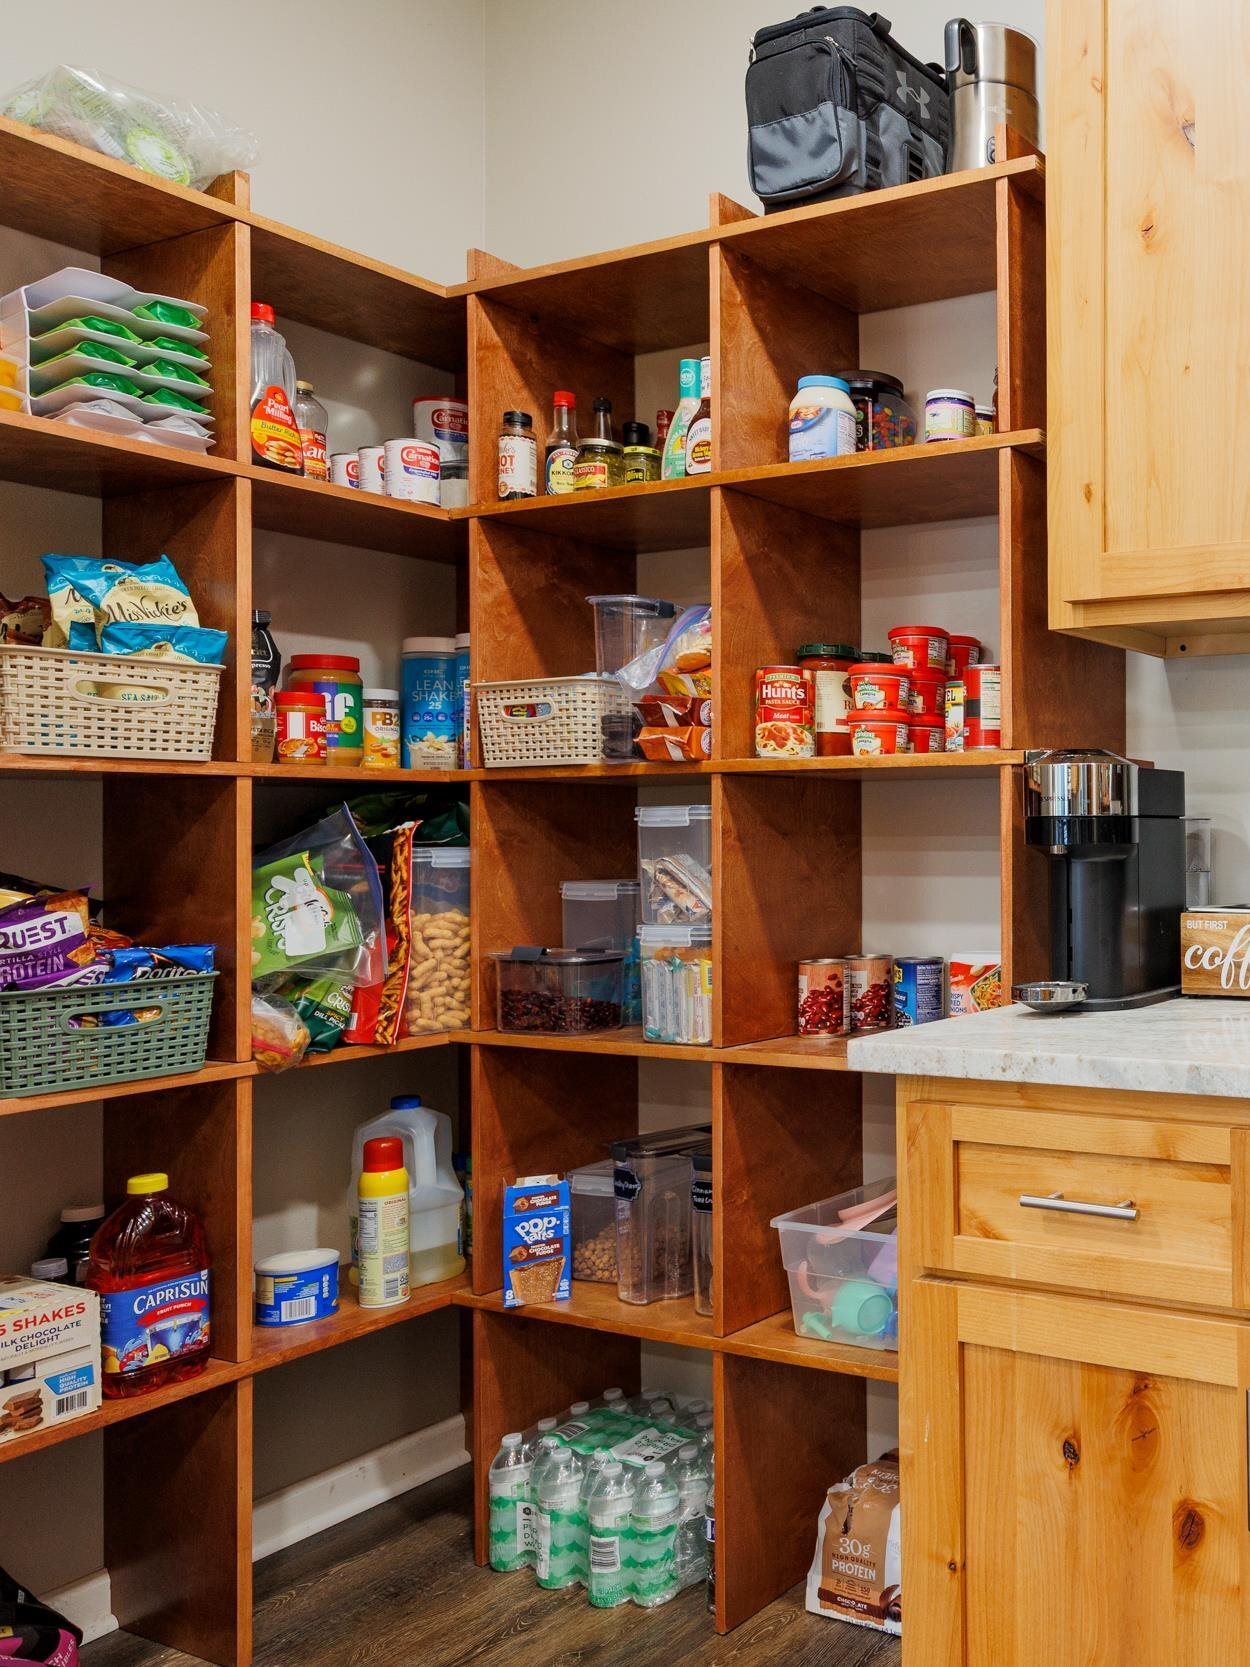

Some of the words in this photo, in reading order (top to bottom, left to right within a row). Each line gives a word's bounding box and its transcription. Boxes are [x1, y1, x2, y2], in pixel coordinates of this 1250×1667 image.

[267, 398, 290, 414] Pearl
[263, 405, 292, 425] Milling
[260, 421, 284, 434] Butter
[136, 594, 188, 622] Vickie's
[416, 680, 453, 690] LEAN
[762, 683, 806, 700] Hunt's
[412, 691, 457, 701] SHAKE
[428, 701, 442, 710] 25
[773, 712, 789, 720] Meat
[1187, 920, 1203, 930] BUT
[1205, 920, 1228, 930] FIRST
[314, 1010, 328, 1023] DILL
[327, 1010, 345, 1023] SPICY
[529, 1195, 557, 1204] CHOCOLATE
[524, 1229, 555, 1244] tarts
[528, 1244, 560, 1256] CHOCOLATE
[536, 1248, 554, 1256] FUDGE
[505, 1290, 514, 1300] 8
[157, 1305, 173, 1316] FRUIT
[173, 1301, 192, 1312] PUNCH
[13, 1302, 86, 1333] SHAKES
[0, 1338, 18, 1349] ILK
[20, 1320, 82, 1343] CHOCOLATE
[15, 1334, 60, 1352] DELIGHT
[59, 1375, 76, 1384] HIGH
[59, 1377, 88, 1389] QUALITY
[59, 1381, 88, 1393] PROTEIN
[839, 1537, 871, 1558] 30g
[832, 1552, 849, 1562] HIGH
[850, 1556, 876, 1567] QUALITY
[832, 1559, 876, 1580] PROTEIN
